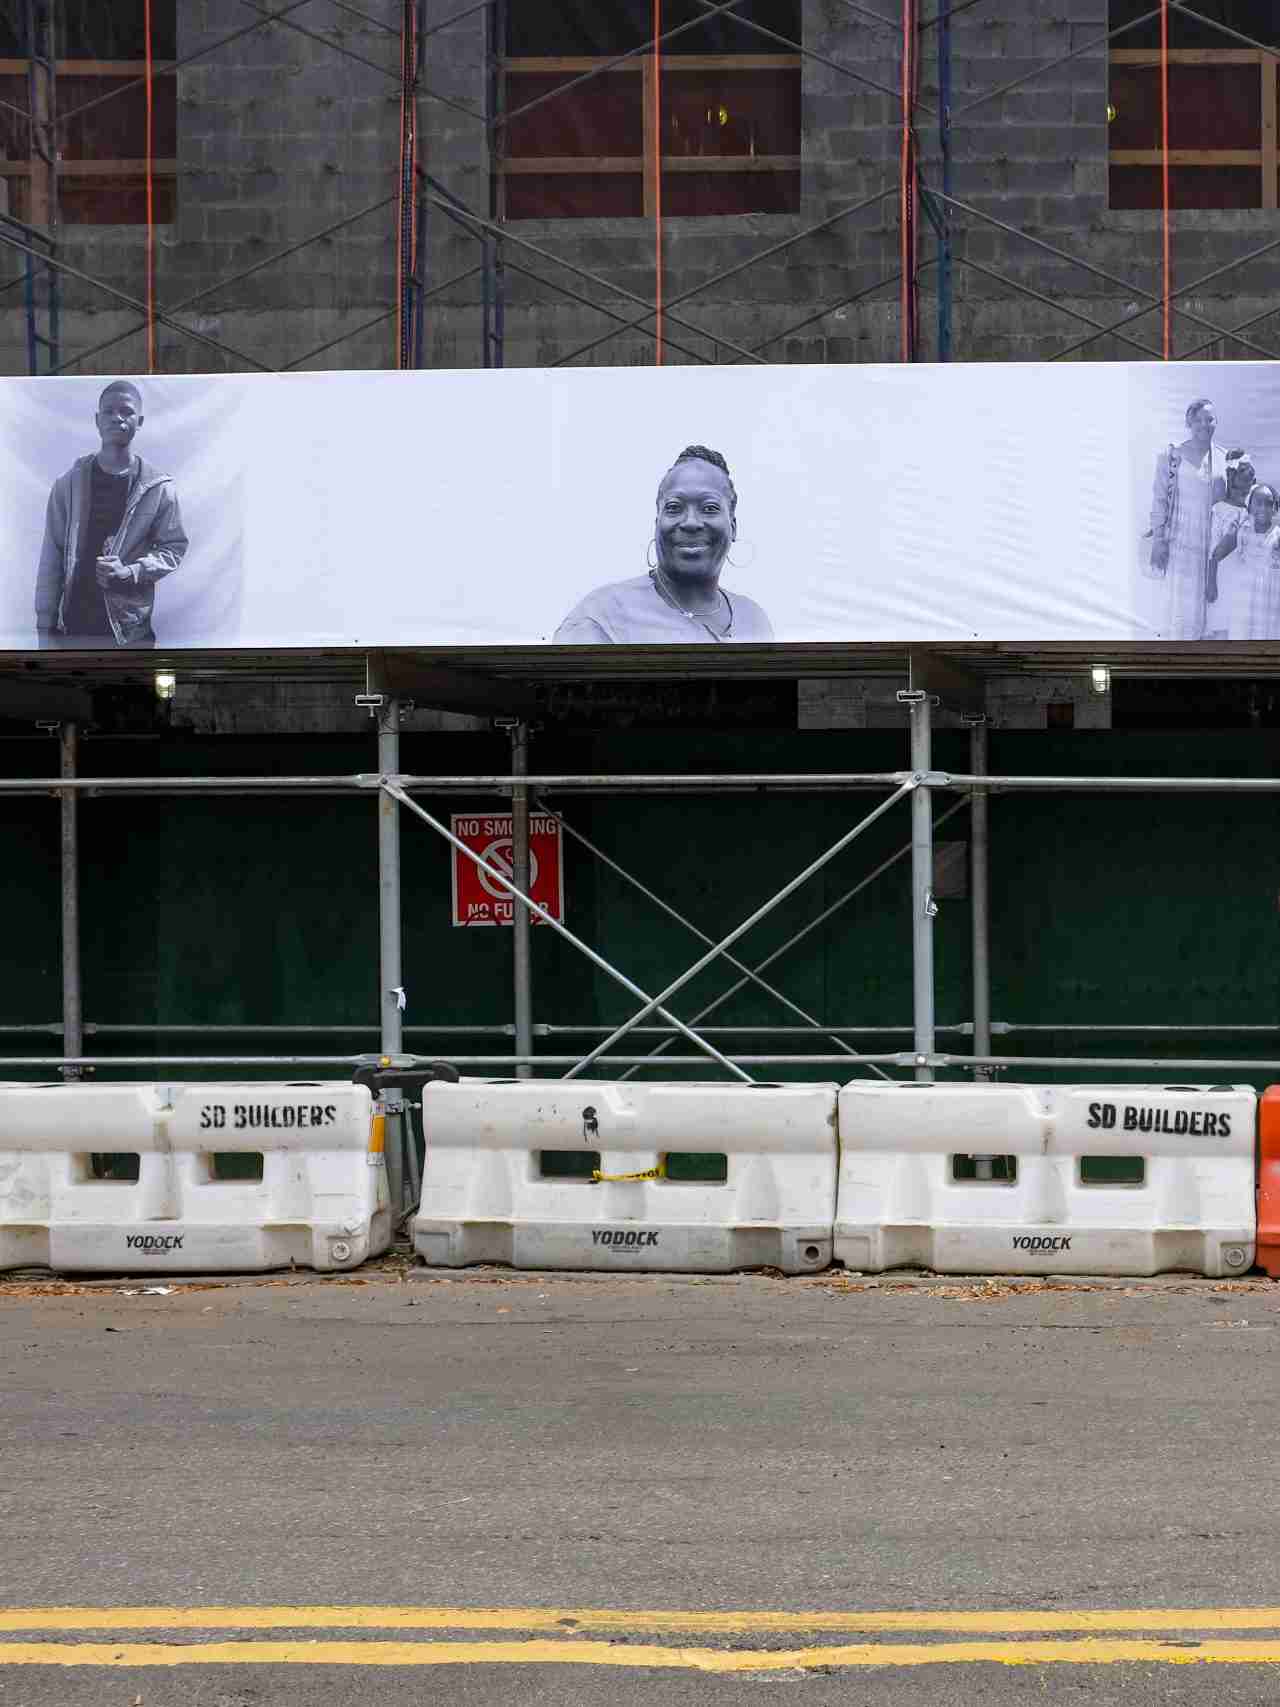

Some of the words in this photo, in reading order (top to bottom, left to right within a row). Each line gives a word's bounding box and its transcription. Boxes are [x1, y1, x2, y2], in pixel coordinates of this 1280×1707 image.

[458, 820, 480, 836] NO
[484, 819, 556, 836] SMING
[467, 903, 489, 919] NO
[199, 1105, 226, 1128] SD
[233, 1105, 337, 1128] BUILDERS
[1087, 1102, 1117, 1129] SD
[1123, 1106, 1232, 1138] BUILDERS
[125, 1234, 185, 1249] YODOCK
[592, 1230, 660, 1246] YODOCK
[1012, 1236, 1072, 1250] YODOCK
